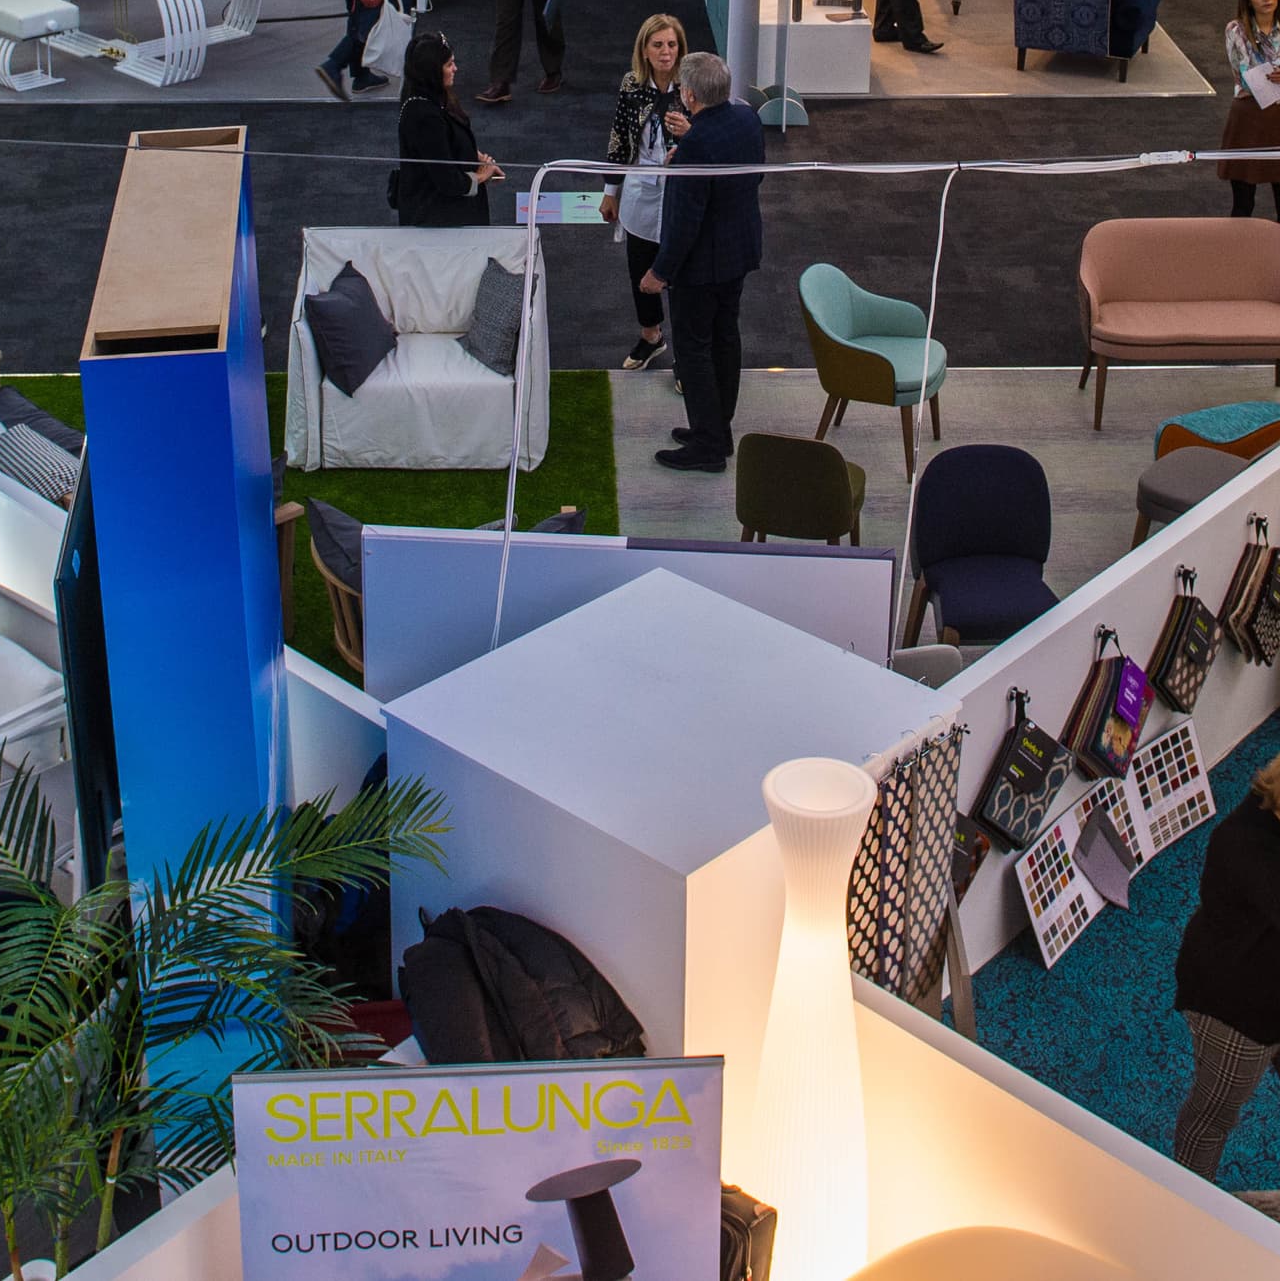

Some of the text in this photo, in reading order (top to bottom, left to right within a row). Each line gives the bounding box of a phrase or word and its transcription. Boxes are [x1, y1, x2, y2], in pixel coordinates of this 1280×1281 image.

[264, 1078, 693, 1144] SERRALUNGA
[266, 1148, 410, 1168] MADE IN ITALY
[596, 1138, 644, 1155] Since
[271, 1223, 524, 1255] OUTDOOR LIVING
